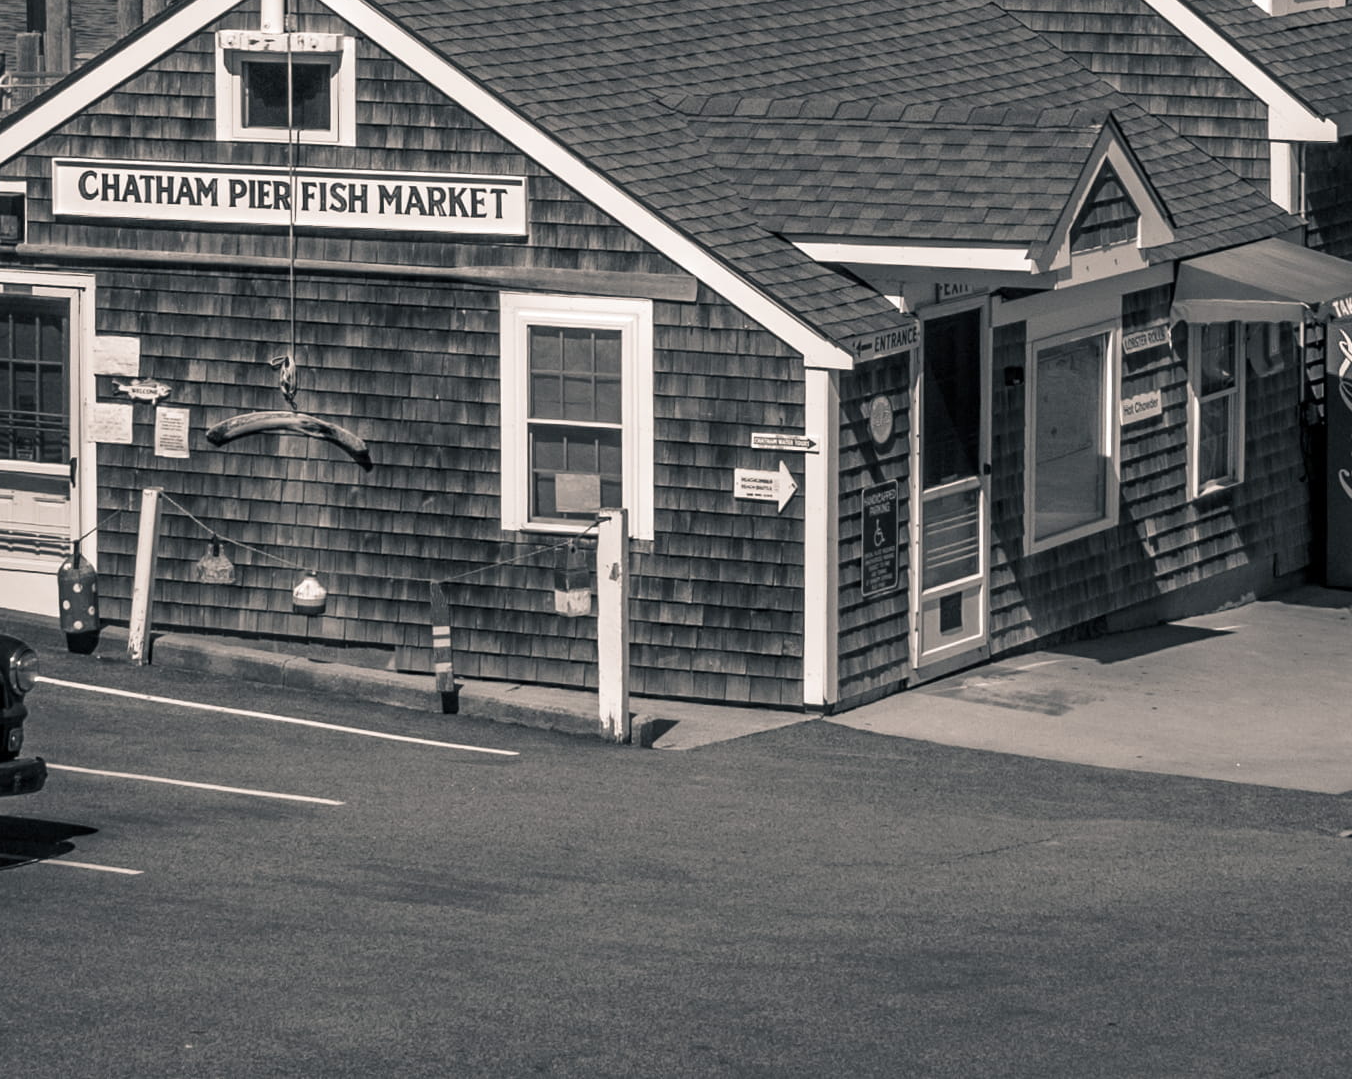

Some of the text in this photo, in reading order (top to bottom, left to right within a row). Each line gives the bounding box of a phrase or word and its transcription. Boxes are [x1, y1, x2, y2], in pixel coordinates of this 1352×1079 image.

[77, 169, 508, 220] CHATHAM PIER FISH MARKET
[874, 325, 917, 353] ENTRANCE
[1134, 398, 1159, 413] Chowder
